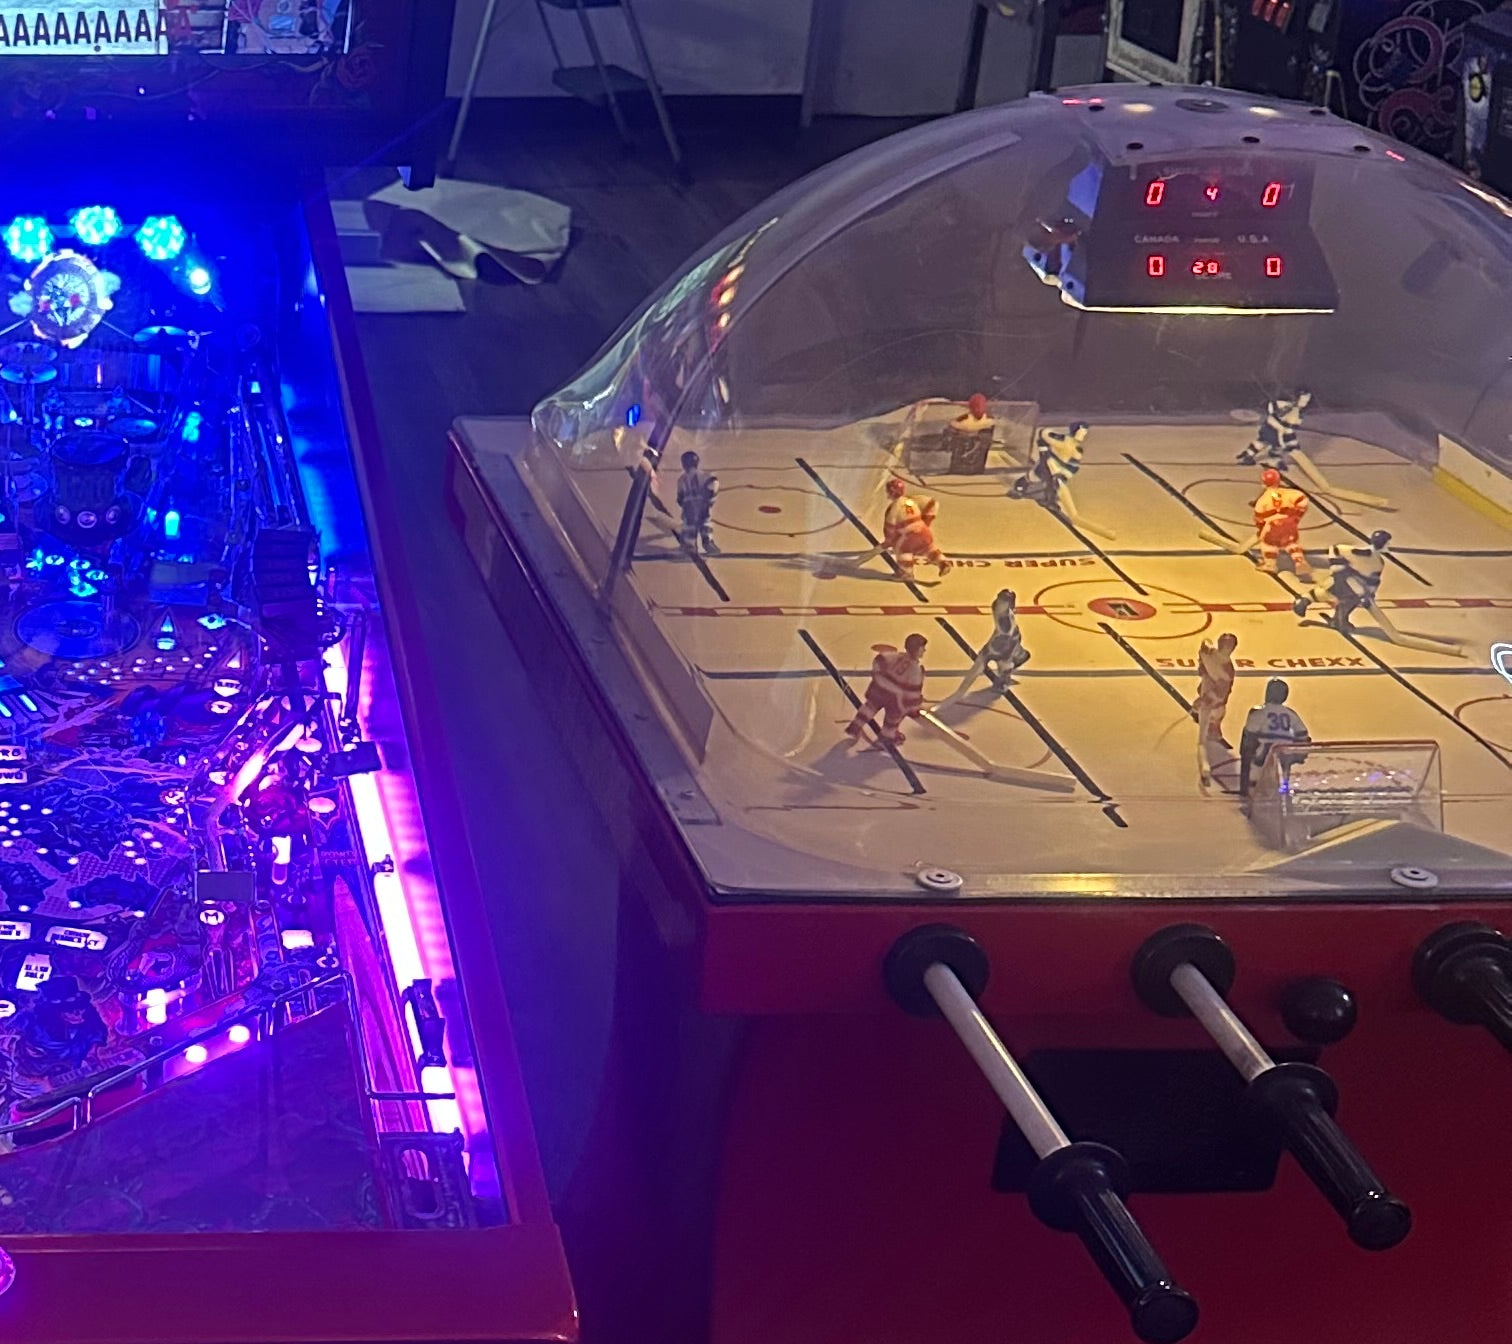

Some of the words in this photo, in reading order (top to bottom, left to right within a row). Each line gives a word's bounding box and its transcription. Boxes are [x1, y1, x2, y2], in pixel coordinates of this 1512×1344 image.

[1146, 181, 1165, 206] 0
[1206, 186, 1218, 201] 4
[1262, 182, 1281, 207] 0
[1148, 256, 1165, 276] 0
[1192, 260, 1219, 274] 20
[1265, 257, 1282, 276] 0
[1155, 657, 1255, 668] SUR
[1267, 656, 1365, 669] CHEXX
[1267, 712, 1291, 732] 30
